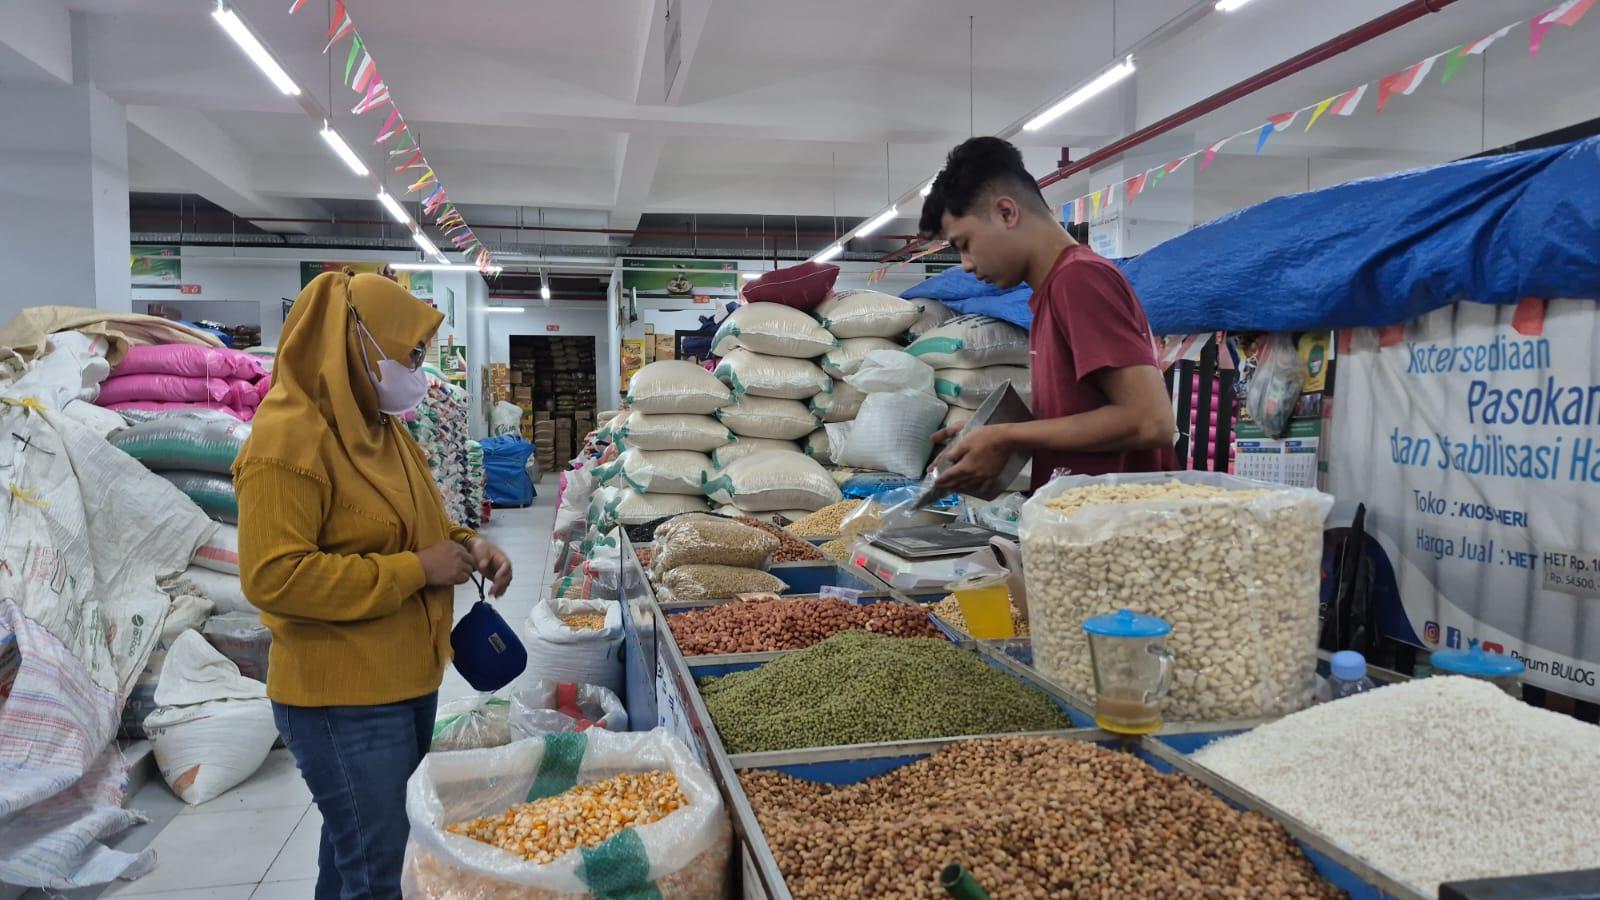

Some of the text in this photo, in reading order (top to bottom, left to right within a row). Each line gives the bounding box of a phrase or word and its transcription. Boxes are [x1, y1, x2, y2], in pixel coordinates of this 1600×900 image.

[1407, 335, 1550, 374] Ketersediaan
[1467, 376, 1600, 426] Pasokan
[1390, 427, 1432, 467] dan
[1413, 489, 1446, 515] Toko
[1416, 528, 1454, 560] Harga
[1458, 536, 1494, 563] Jual
[1506, 550, 1538, 570] HET
[1543, 552, 1568, 568] HET
[1551, 661, 1595, 687] BULOG
